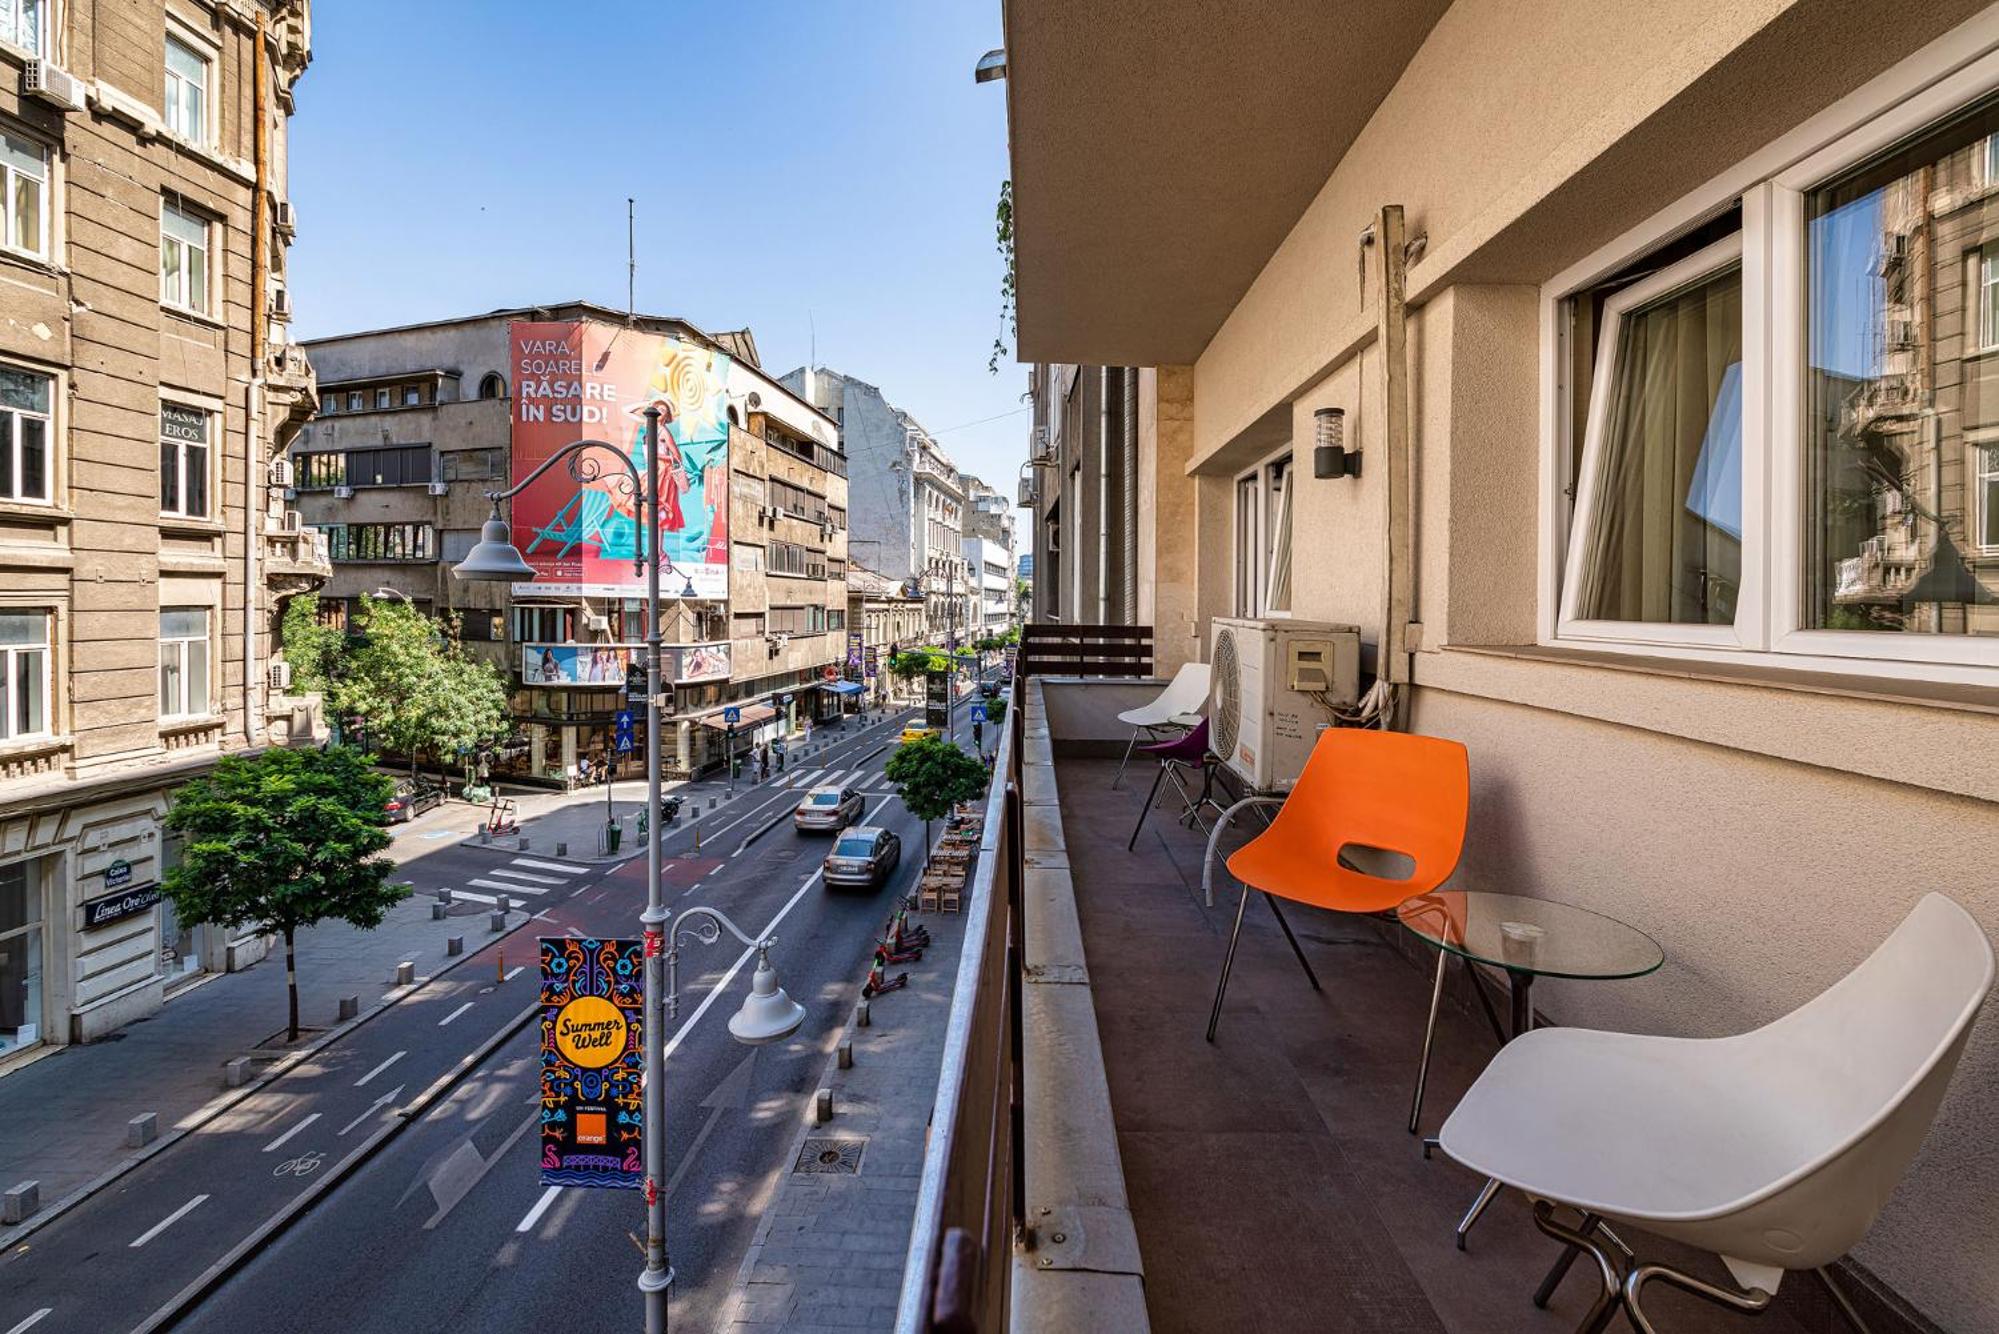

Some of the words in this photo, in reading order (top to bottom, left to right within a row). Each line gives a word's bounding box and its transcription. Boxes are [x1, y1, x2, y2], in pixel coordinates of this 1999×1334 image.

[521, 375, 617, 401] RĂSARE
[521, 398, 545, 422] ÎN
[551, 404, 608, 424] SUD!
[165, 423, 199, 440] EROS
[95, 903, 121, 919] Linea
[560, 1018, 623, 1036] Summer
[572, 1031, 612, 1050] Well
